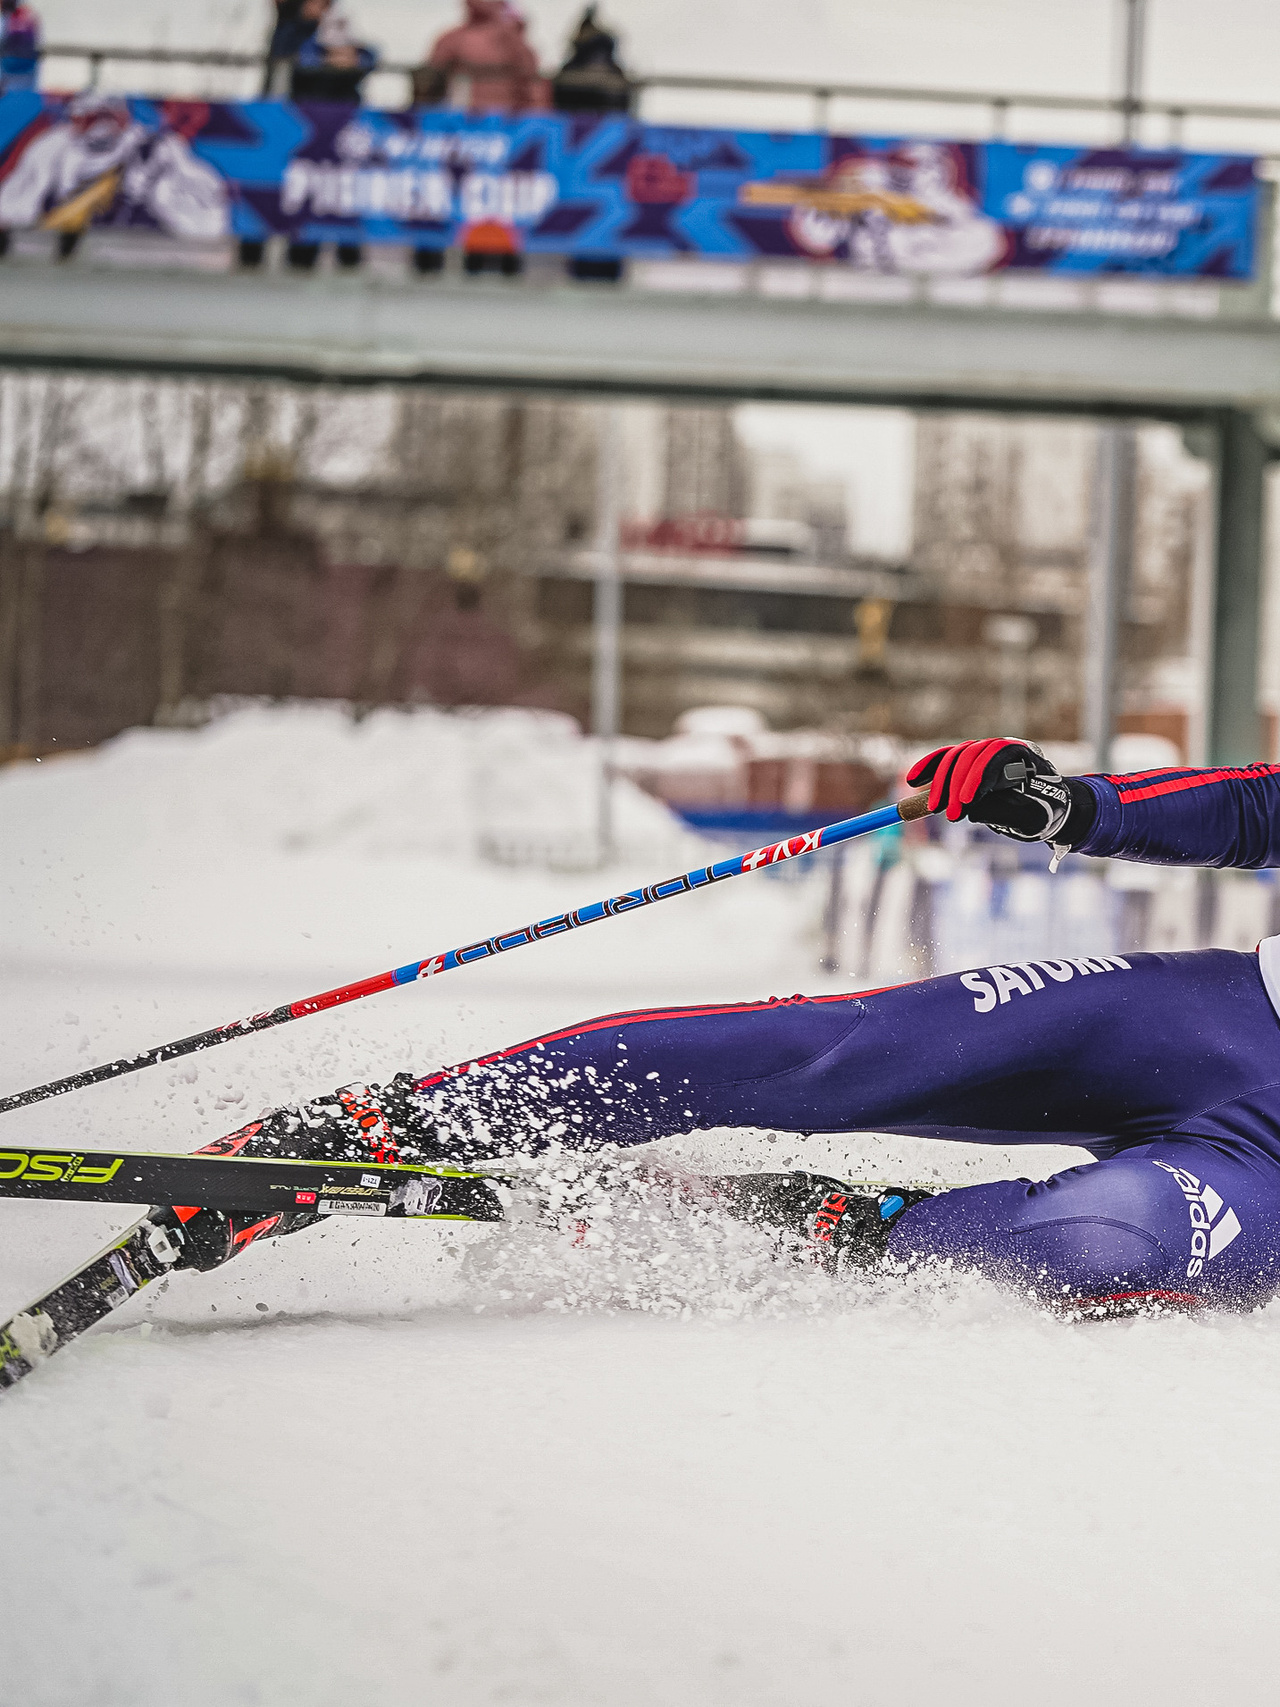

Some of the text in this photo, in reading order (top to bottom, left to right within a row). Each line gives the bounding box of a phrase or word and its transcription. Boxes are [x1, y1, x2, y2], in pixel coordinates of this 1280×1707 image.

[455, 866, 736, 966] TORNADO
[959, 955, 1133, 1013] SATURN
[1151, 1161, 1212, 1278] adidas
